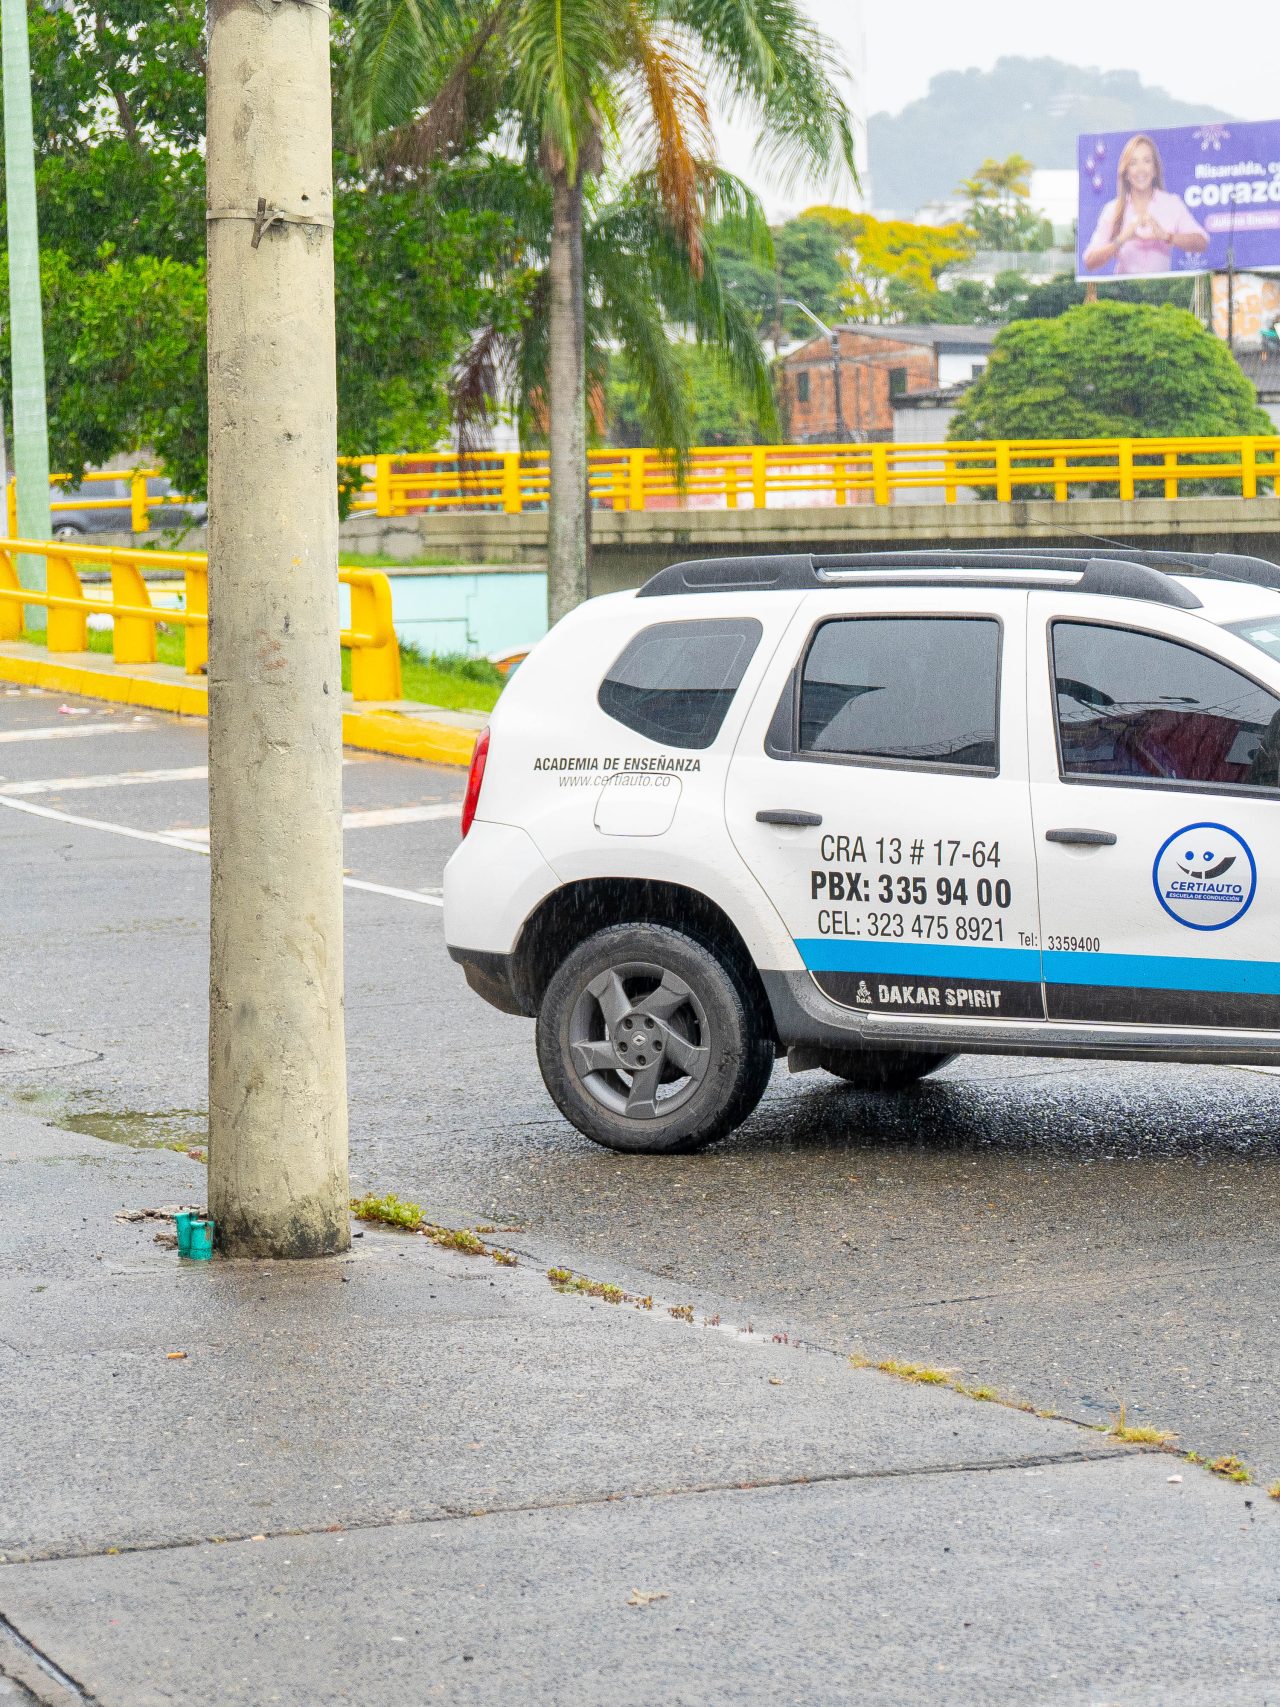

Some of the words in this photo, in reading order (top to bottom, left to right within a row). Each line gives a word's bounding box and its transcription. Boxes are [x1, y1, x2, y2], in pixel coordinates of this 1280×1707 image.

[533, 757, 599, 771] ACADEMIA
[603, 757, 620, 771] DE
[623, 754, 701, 772] ENSEÑANZA
[558, 773, 671, 788] www.certiauto.co
[820, 834, 867, 863] CRA
[875, 837, 902, 865] 13
[909, 839, 925, 866] #
[933, 839, 1001, 868] 17-64
[811, 870, 870, 902] PBX:
[878, 874, 928, 905] 335
[936, 877, 969, 906] 94
[976, 878, 1012, 909] 00
[1170, 881, 1243, 894] CERTIAUTO
[818, 909, 861, 936] CEL:
[867, 912, 904, 938] 323
[911, 914, 949, 940] 475
[955, 916, 1004, 942] 8921
[1017, 931, 1038, 947] Tel:
[1047, 936, 1100, 952] 3359400
[878, 984, 941, 1006] DAKAR
